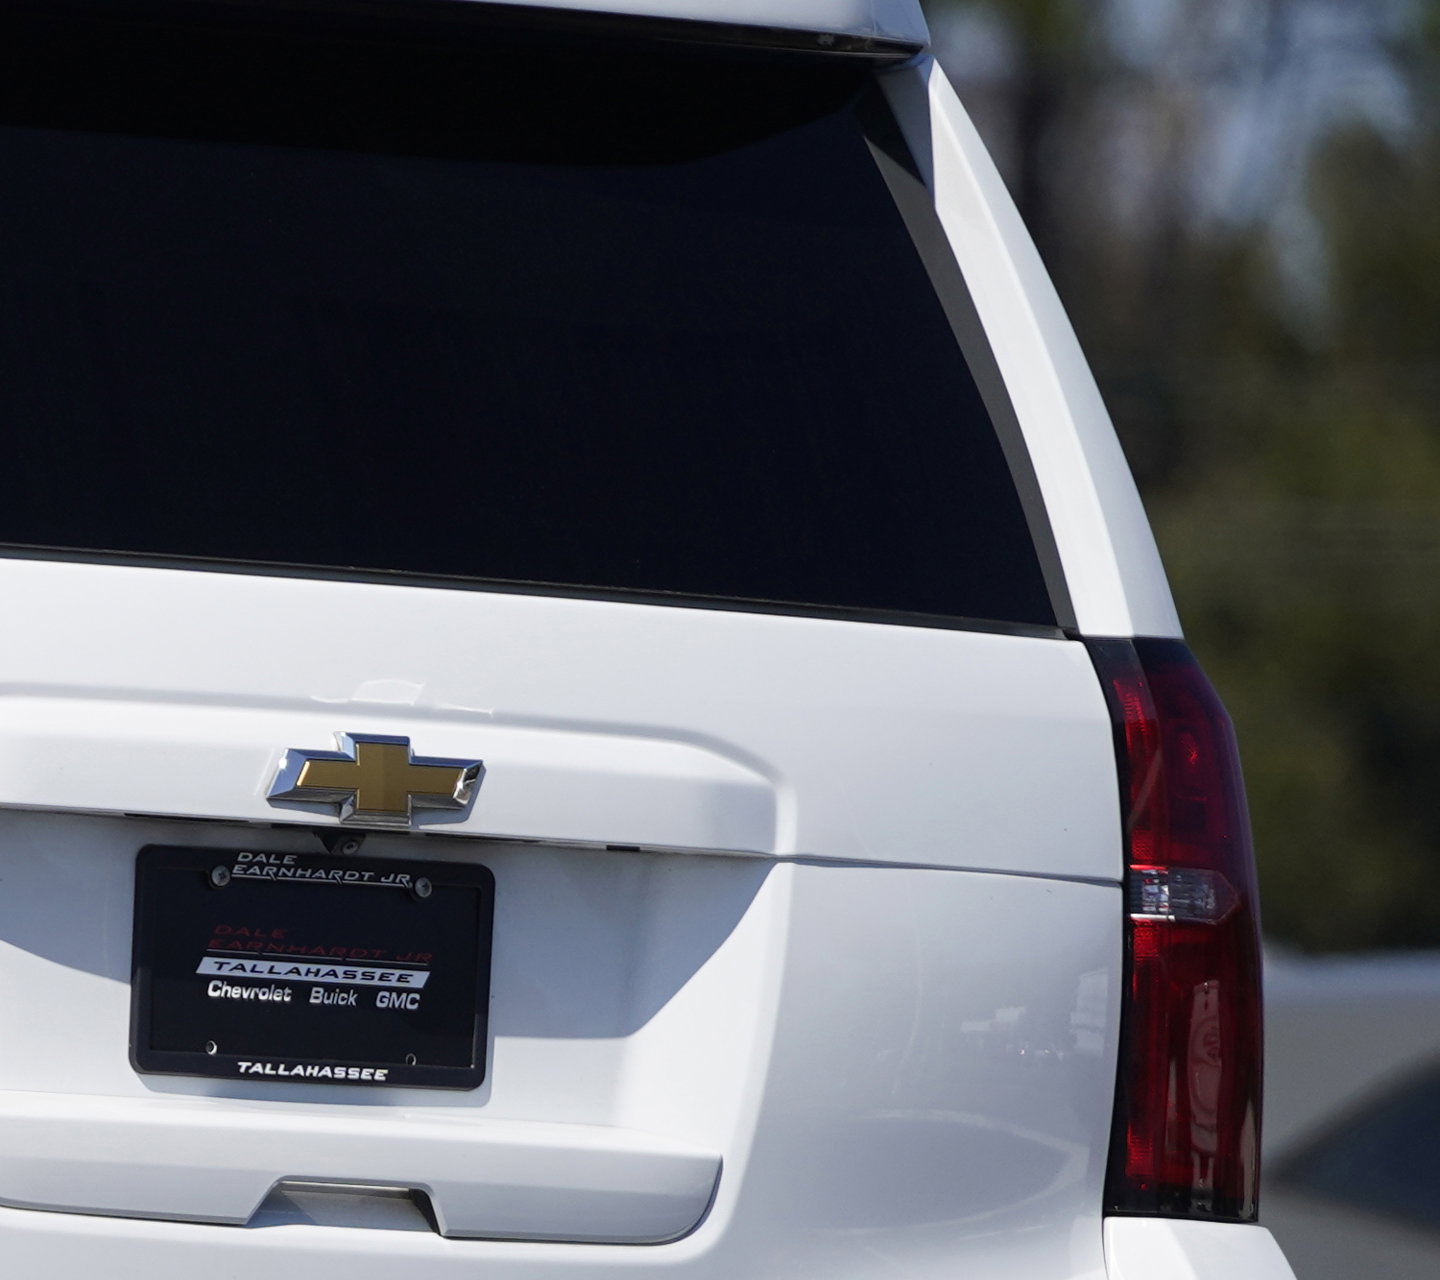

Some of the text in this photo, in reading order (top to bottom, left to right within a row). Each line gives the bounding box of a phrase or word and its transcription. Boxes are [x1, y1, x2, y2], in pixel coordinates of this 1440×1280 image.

[237, 851, 298, 866] DALE
[231, 864, 375, 885] EARNHARDT
[212, 924, 288, 939] DALE
[206, 937, 433, 963] EARNHARDT JR
[212, 961, 414, 983] TALLAHASSEE
[207, 981, 421, 1010] Chevrolet Buick GMC
[237, 1061, 388, 1081] TALLAHASSEE
